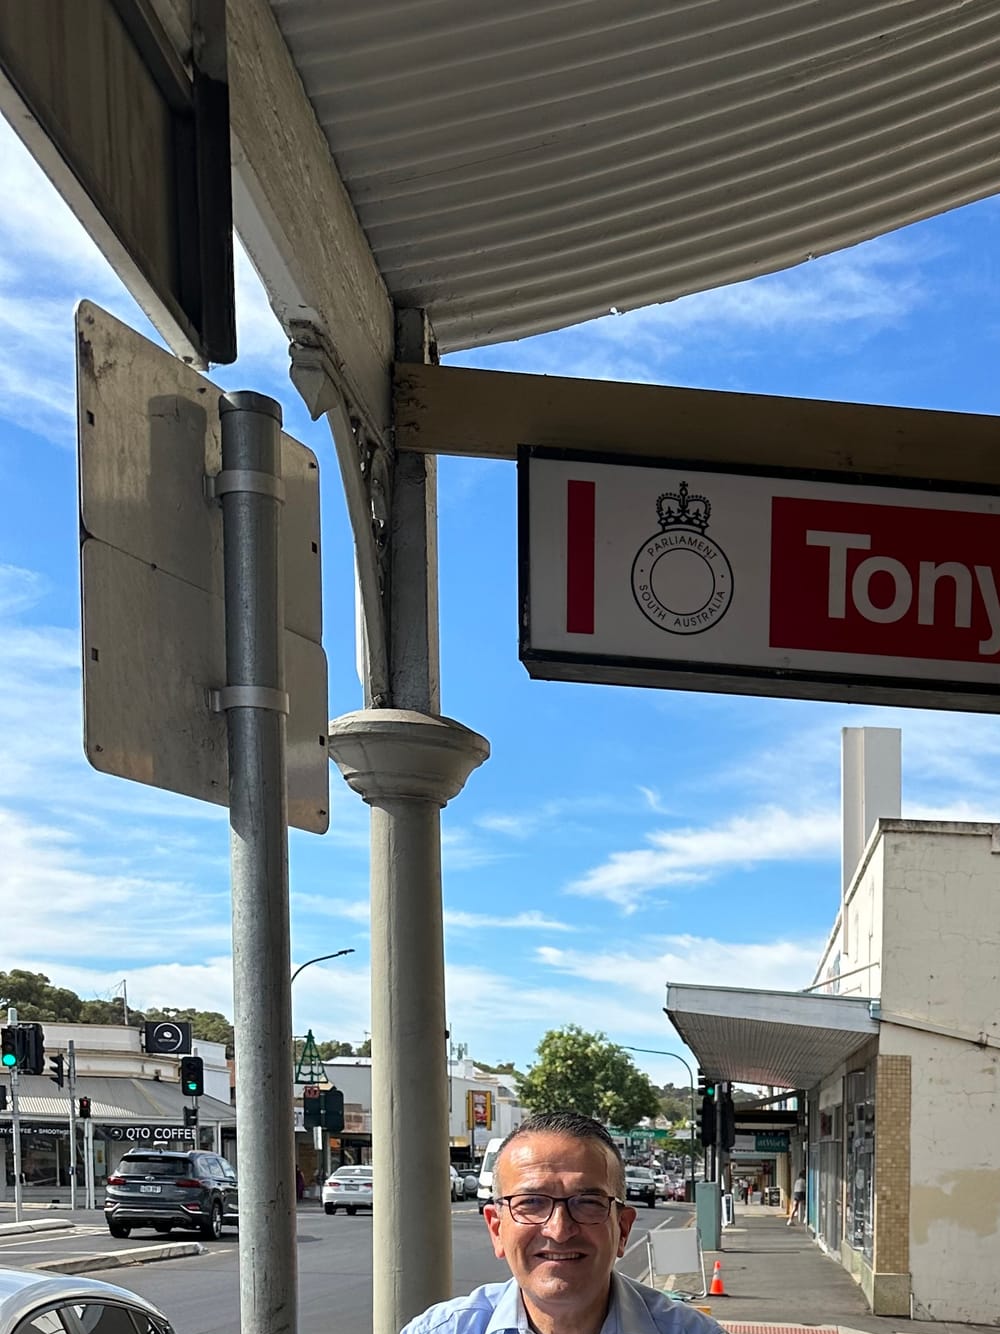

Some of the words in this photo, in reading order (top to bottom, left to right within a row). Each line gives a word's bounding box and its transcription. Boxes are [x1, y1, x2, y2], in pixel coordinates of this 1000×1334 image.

[647, 535, 717, 561] PARLIAMENT
[639, 584, 667, 621] SOUTH
[674, 590, 726, 627] AUSTRALIA
[126, 1127, 150, 1140] QTO
